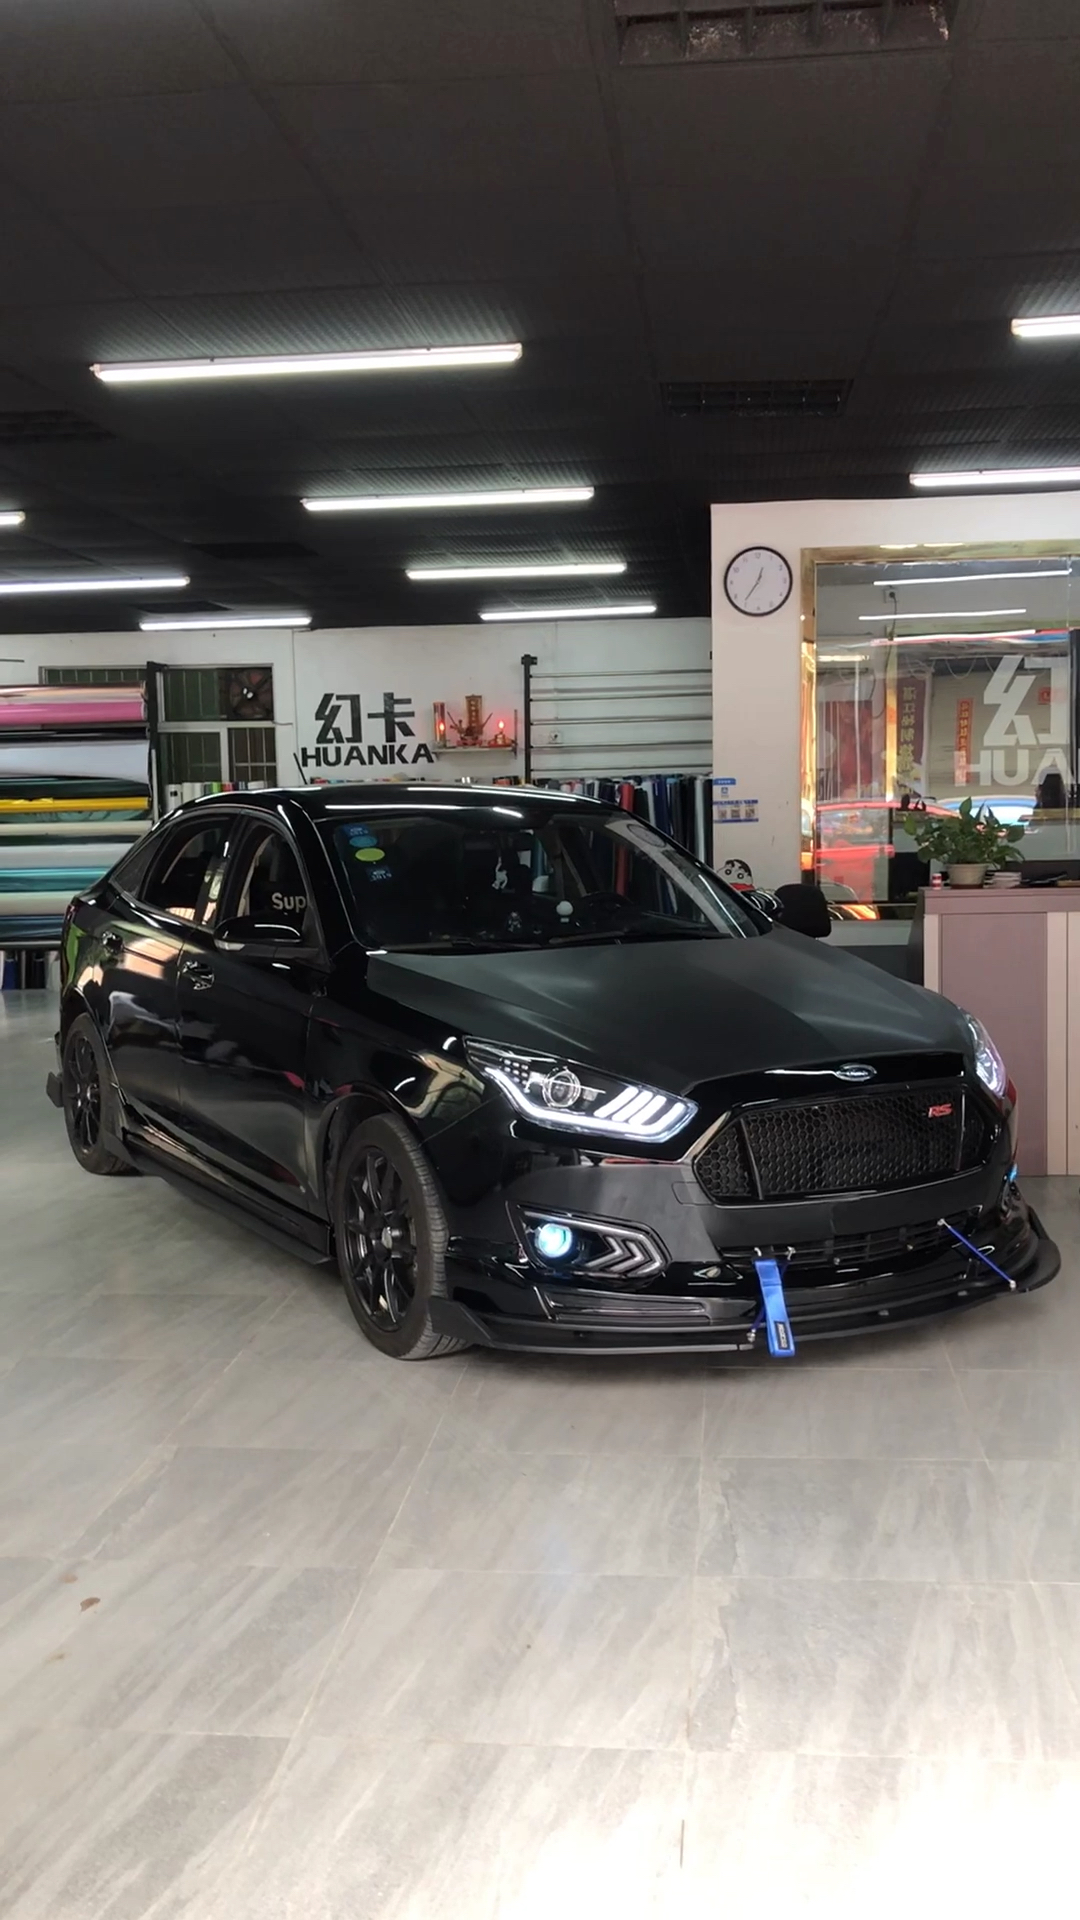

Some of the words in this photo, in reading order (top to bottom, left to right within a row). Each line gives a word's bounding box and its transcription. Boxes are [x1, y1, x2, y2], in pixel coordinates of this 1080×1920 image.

[983, 654, 1070, 746] 幻
[315, 692, 415, 744] 幻卡
[301, 743, 434, 767] HUANKA
[954, 748, 1080, 787] HUA
[271, 892, 307, 913] Sup
[928, 1103, 952, 1118] RS
